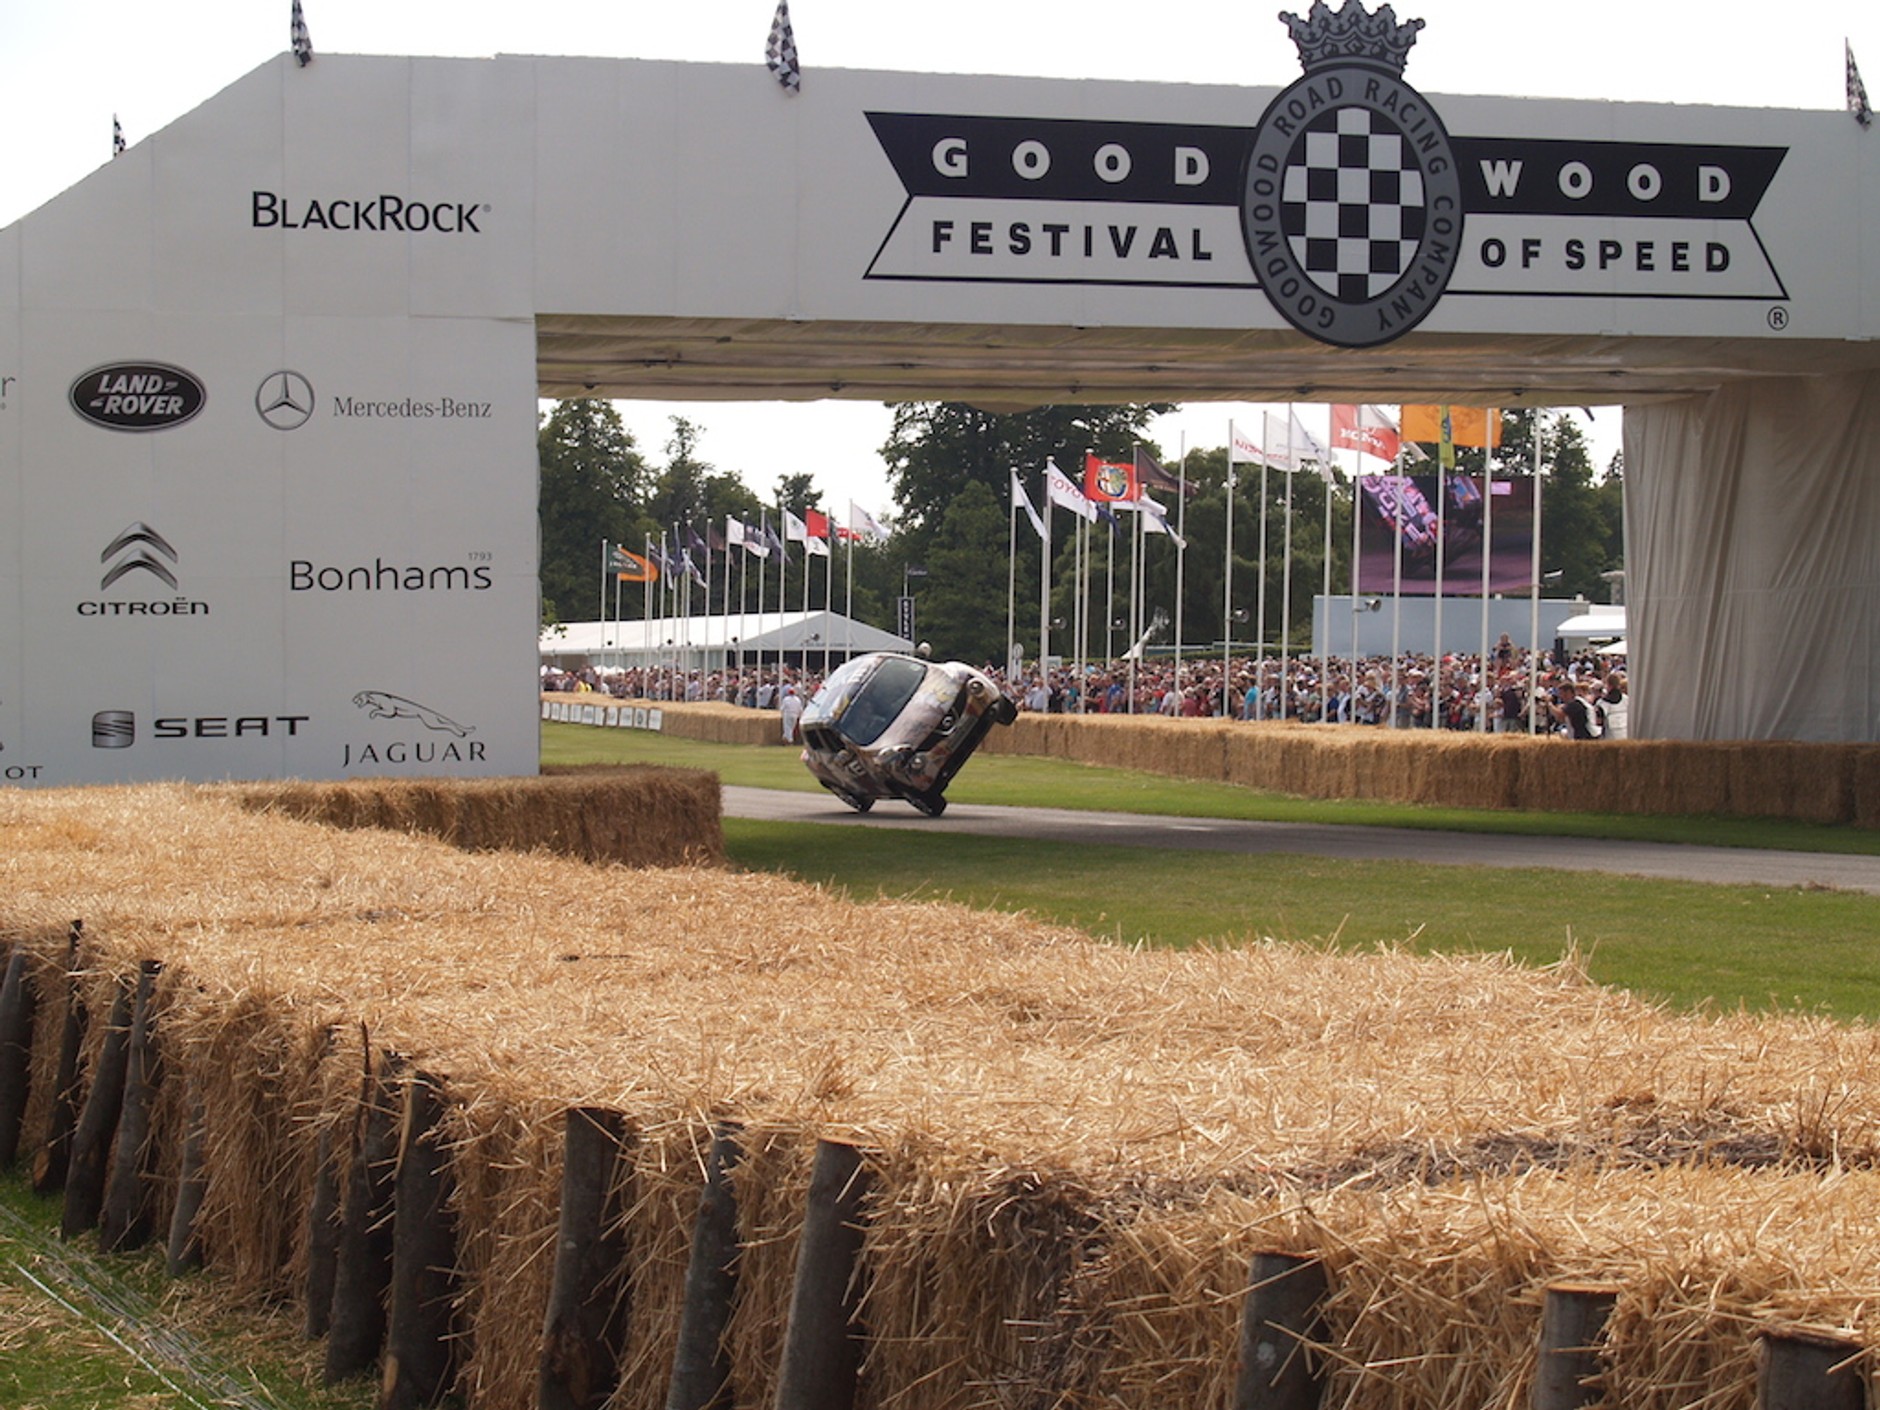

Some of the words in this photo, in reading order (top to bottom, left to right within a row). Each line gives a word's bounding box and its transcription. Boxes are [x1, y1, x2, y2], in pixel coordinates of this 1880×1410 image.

[1272, 76, 1344, 138] ROAD
[1364, 77, 1449, 176] RACING
[932, 137, 1210, 186] GOOD
[1480, 159, 1732, 203] WOOD
[931, 220, 1213, 261] FESTIVAL
[1480, 238, 1542, 269] OF
[1565, 239, 1731, 273] SPEED
[1252, 152, 1335, 330] GOODWOOD
[1377, 195, 1454, 332] COMPANY
[98, 374, 163, 395] LAND
[103, 395, 184, 415] ROVER
[333, 396, 492, 418] Mercedes-Benz
[290, 557, 493, 591] Bonhams
[466, 552, 493, 562] 1793
[154, 716, 310, 738] SEAT
[342, 741, 487, 768] JAGUAR
